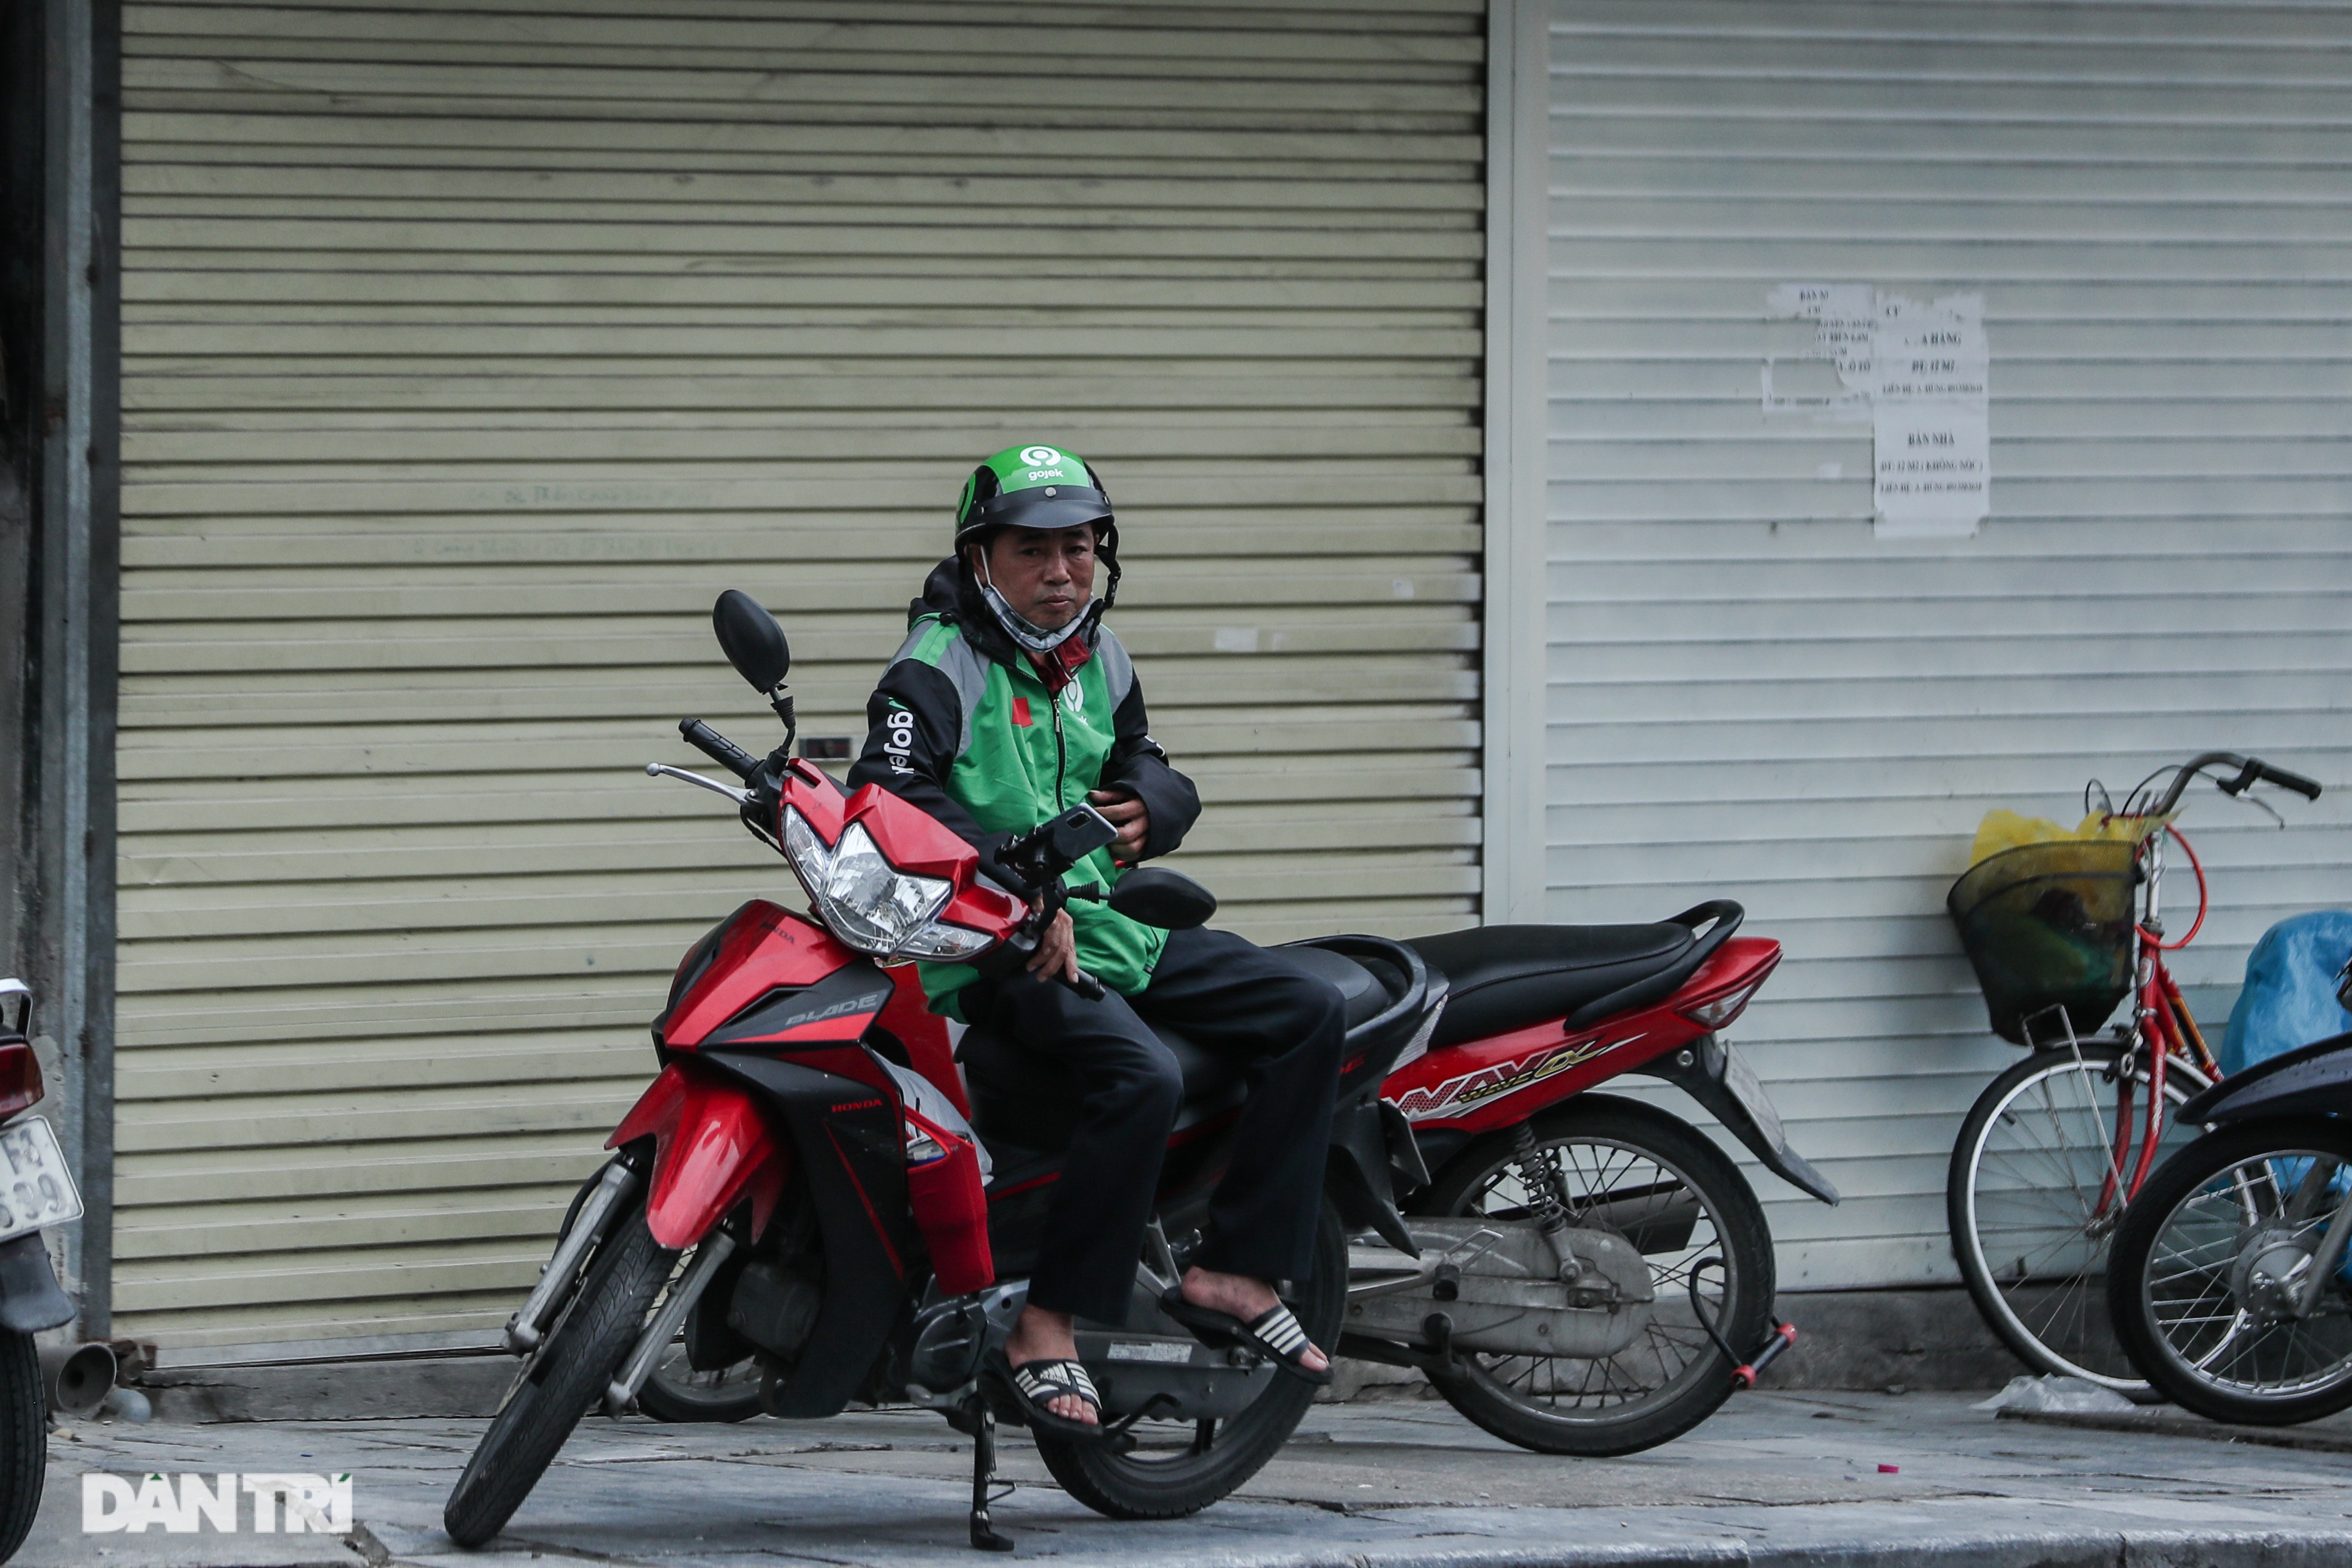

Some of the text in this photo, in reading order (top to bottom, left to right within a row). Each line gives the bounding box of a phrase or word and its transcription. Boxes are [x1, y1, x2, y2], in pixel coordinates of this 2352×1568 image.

[1028, 468, 1064, 481] gojek
[883, 710, 915, 775] gojek
[785, 994, 878, 1026] BLADE
[831, 1098, 883, 1113] HONDA
